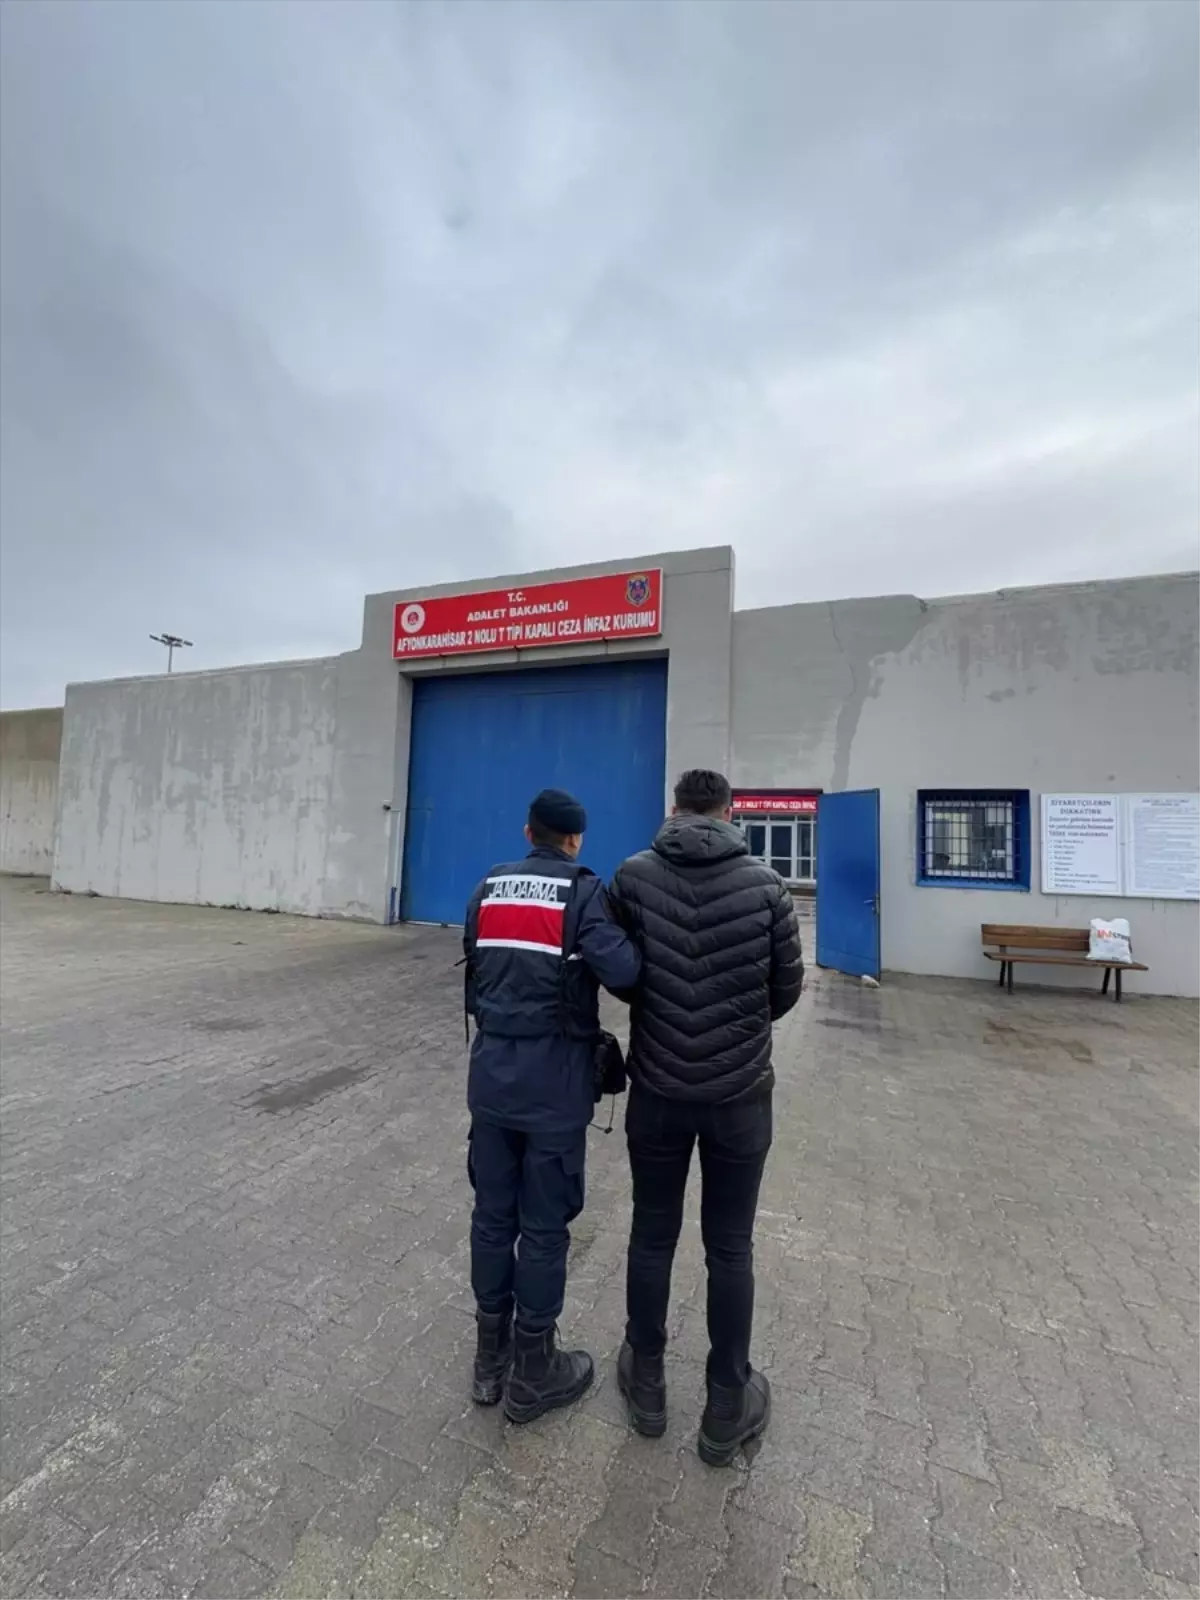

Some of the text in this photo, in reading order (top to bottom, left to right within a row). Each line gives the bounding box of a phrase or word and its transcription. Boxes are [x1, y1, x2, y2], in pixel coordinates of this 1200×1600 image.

[507, 592, 526, 602] T.C.
[467, 600, 569, 622] ADALET BAKANLIĞI
[397, 610, 656, 652] AFYONKARAHİSAR 2 NOLU T TİPİ KAPALI CEZA İNFAZ KURUMU
[488, 880, 559, 902] JANDARMA
